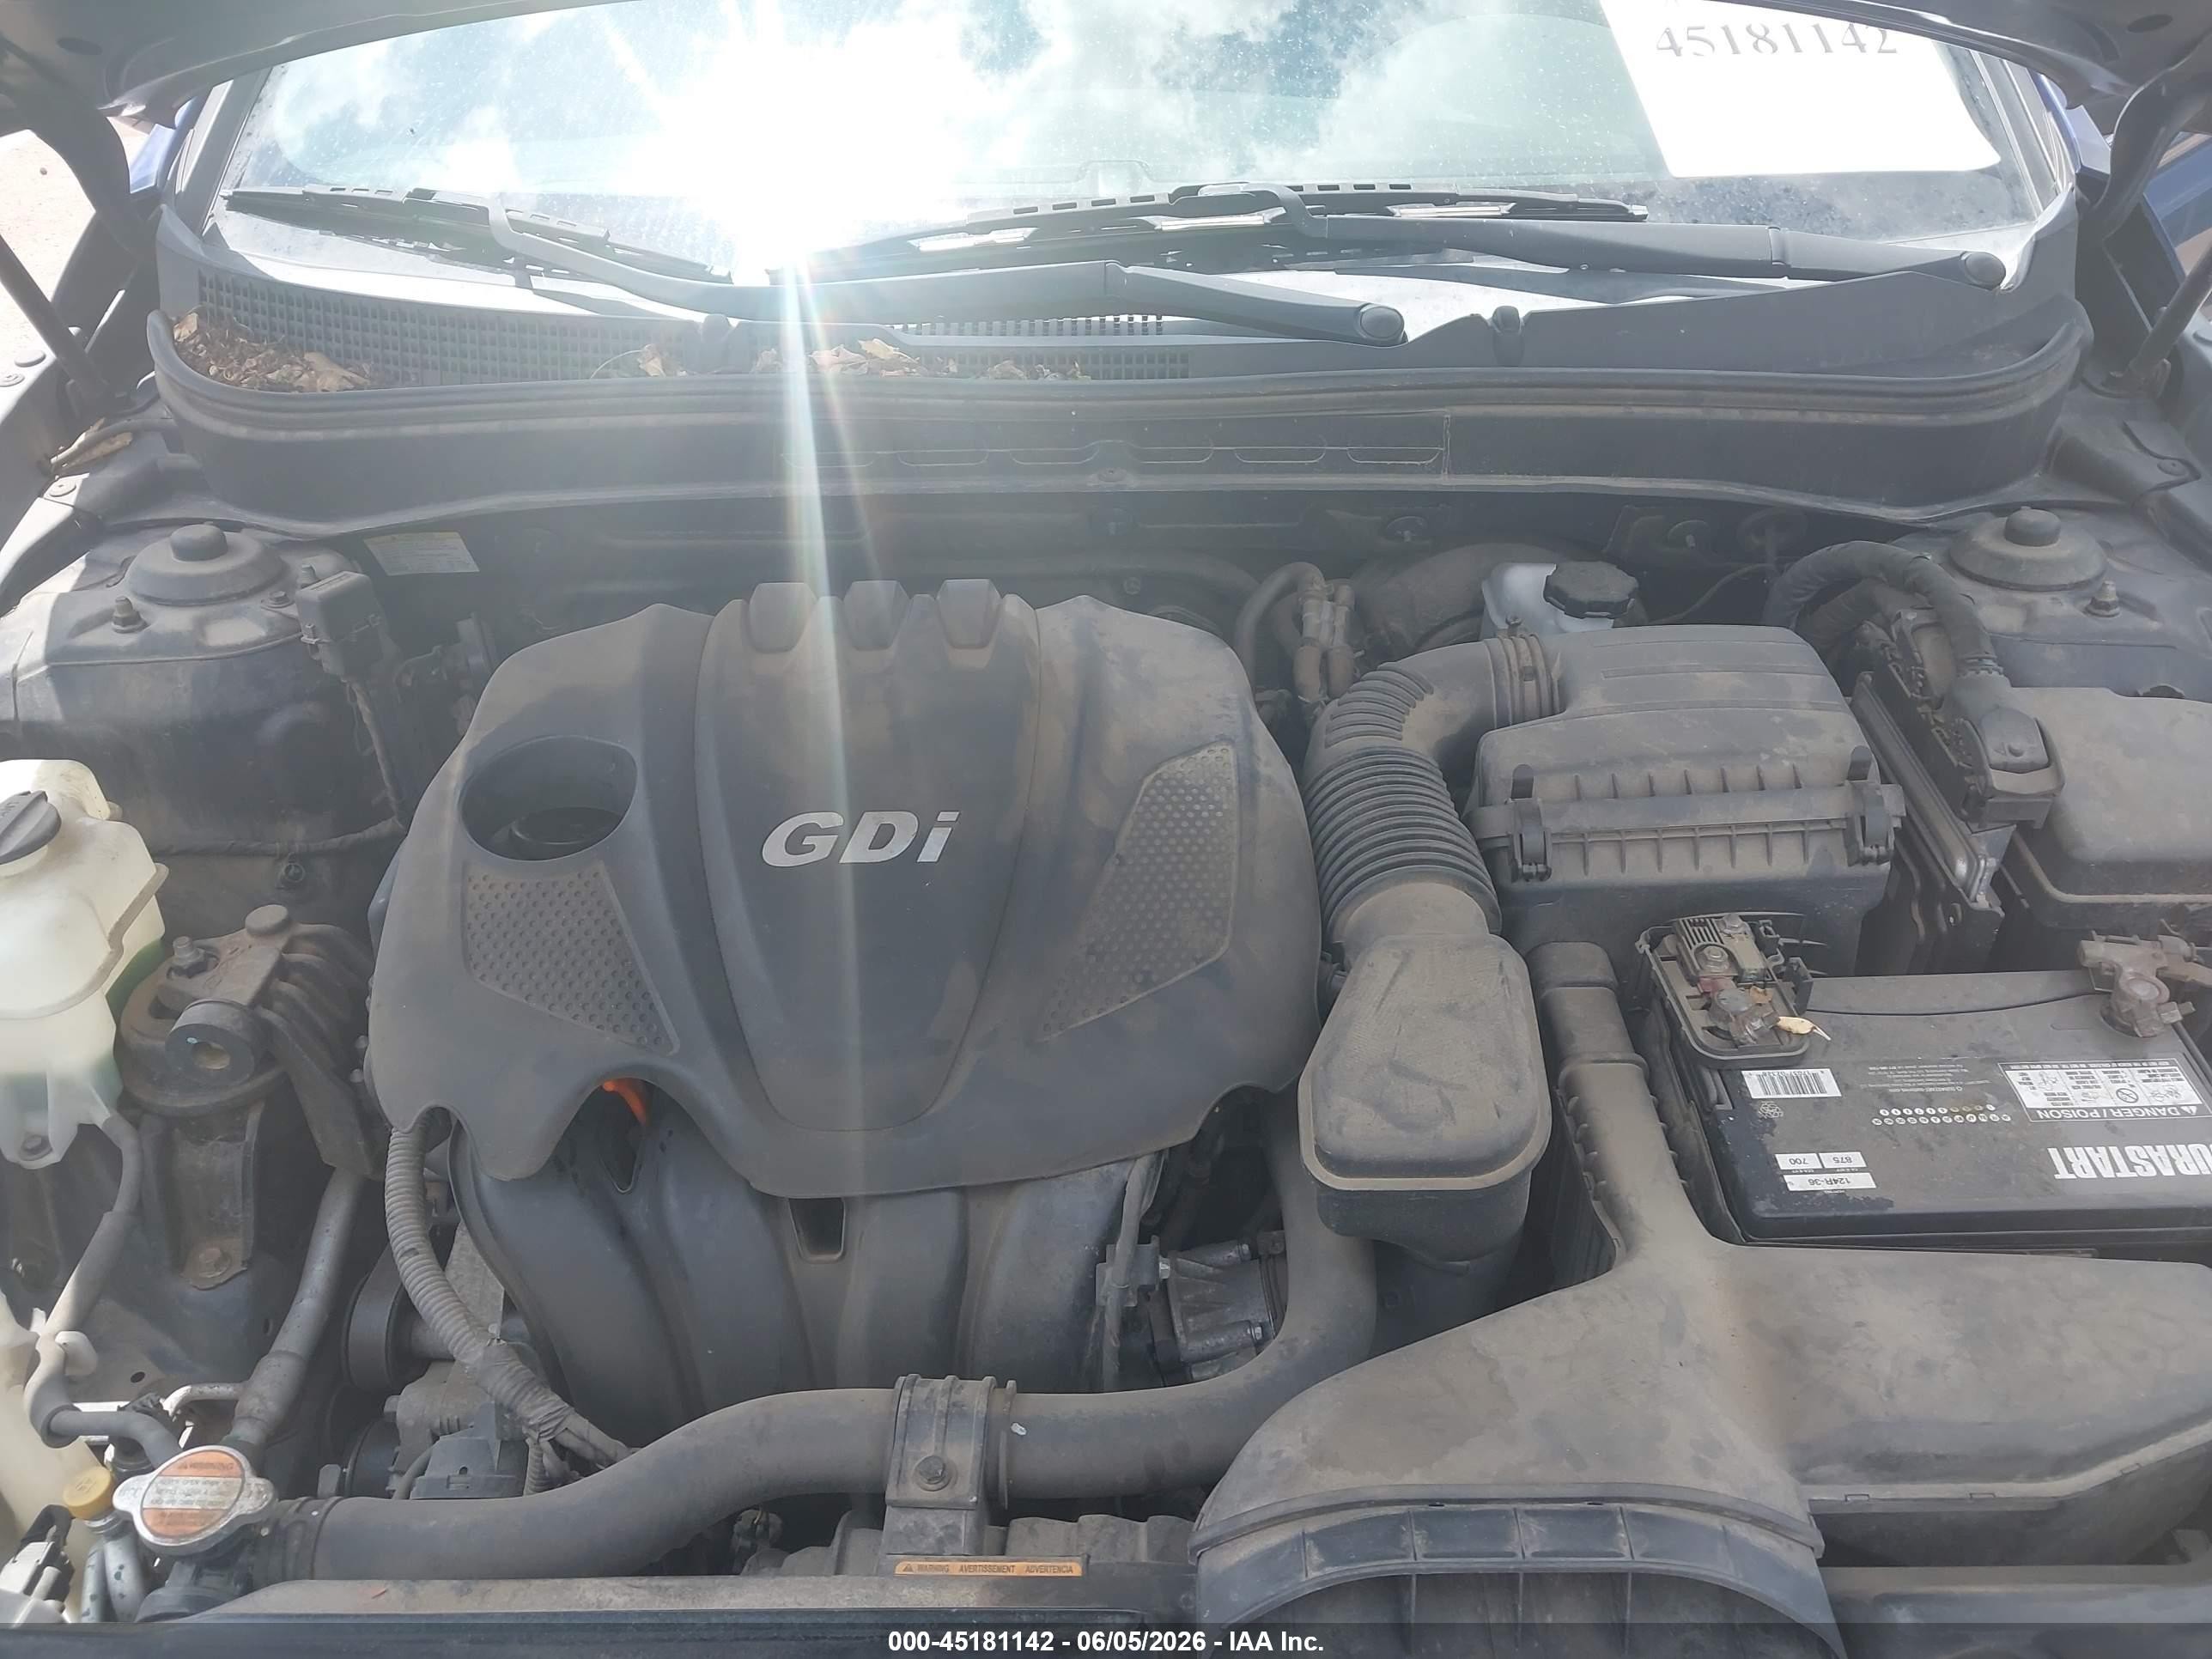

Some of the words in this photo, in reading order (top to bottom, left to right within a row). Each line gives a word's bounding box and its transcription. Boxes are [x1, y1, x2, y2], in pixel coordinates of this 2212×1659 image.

[1656, 22, 1897, 57] 45181142
[762, 811, 960, 867] GDi
[2036, 1109, 2101, 1119] POISON
[2109, 1106, 2181, 1118] DANGER
[1832, 1156, 1852, 1164] 875
[2048, 1144, 2212, 1179] URASTART
[918, 1564, 950, 1573] WARNING
[959, 1564, 1015, 1573] AVERTISSEMENT
[1024, 1564, 1073, 1573] ADVERTENCIA
